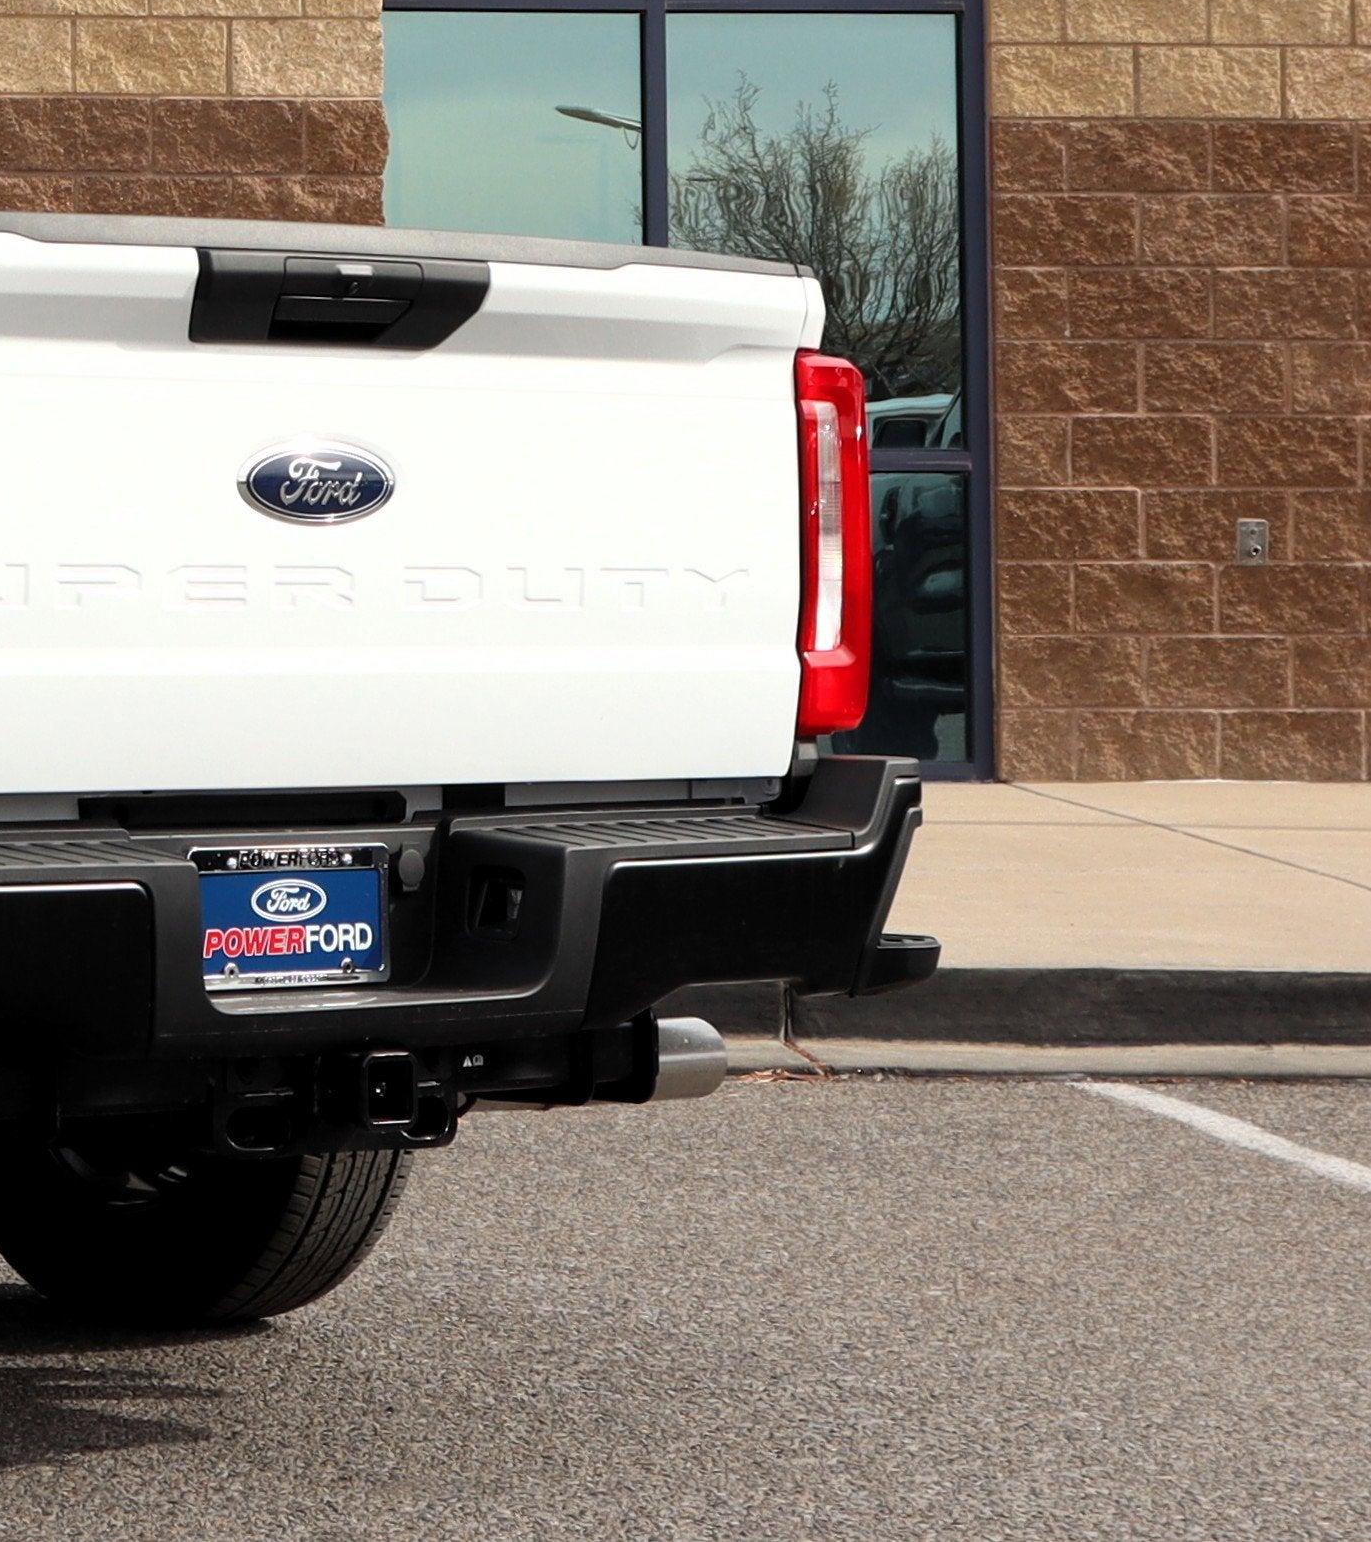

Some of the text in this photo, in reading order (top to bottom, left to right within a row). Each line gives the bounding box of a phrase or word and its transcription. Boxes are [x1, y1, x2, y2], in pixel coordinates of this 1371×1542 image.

[280, 457, 363, 506] Ford
[400, 565, 751, 613] DUTY
[266, 886, 311, 913] Ford
